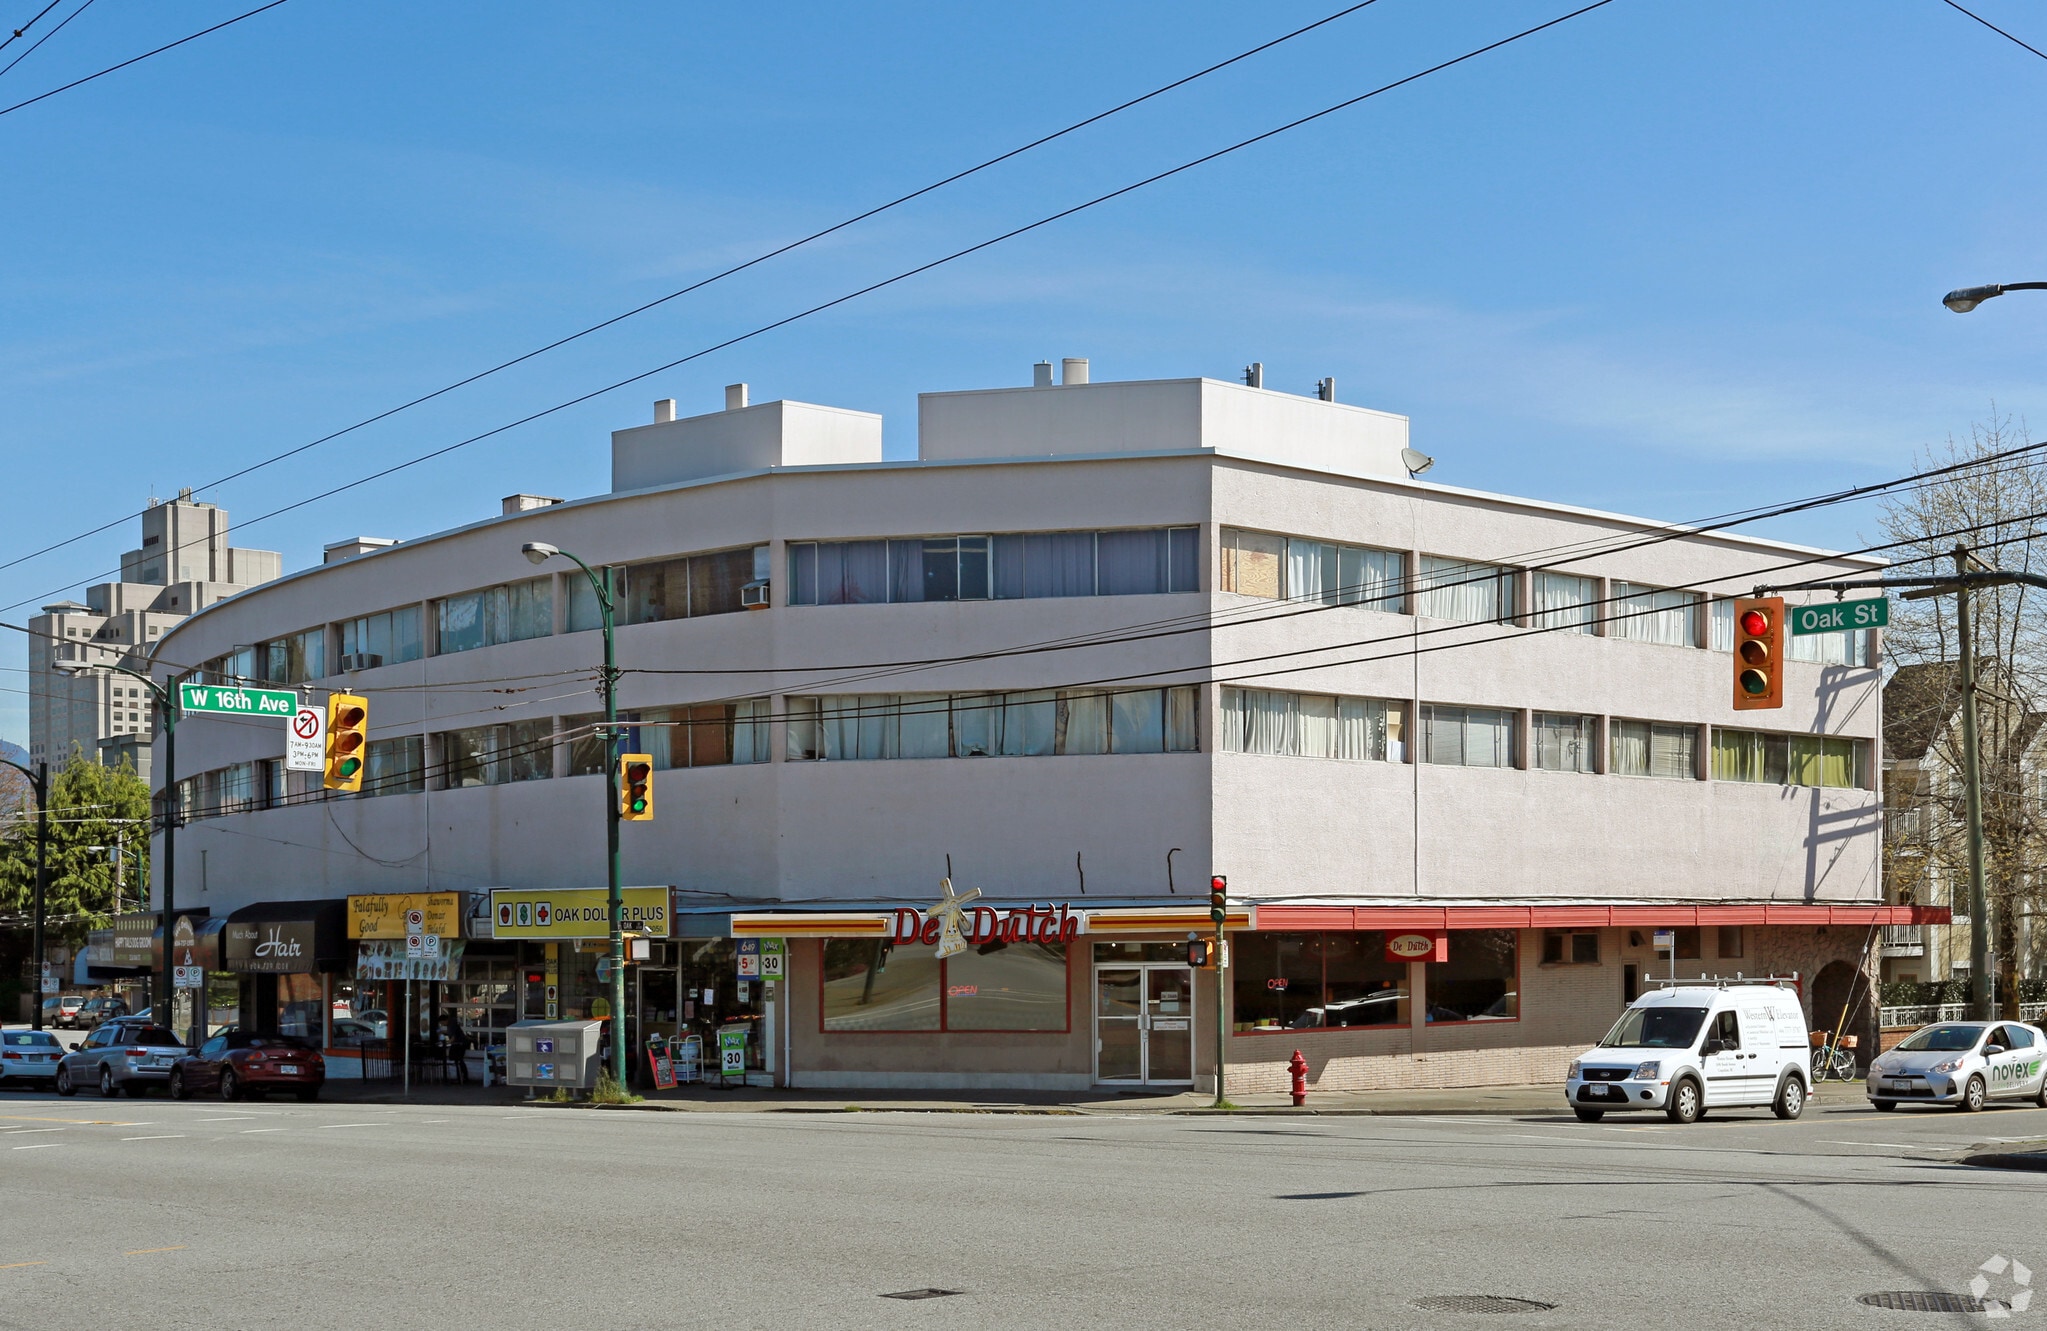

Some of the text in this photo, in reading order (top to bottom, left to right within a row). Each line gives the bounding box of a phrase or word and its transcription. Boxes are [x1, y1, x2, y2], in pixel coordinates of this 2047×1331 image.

[1802, 604, 1878, 629] Oak St
[190, 689, 289, 712] W 16th Ave
[293, 751, 319, 759] 3PM-6PM
[353, 897, 389, 917] Falafully
[555, 906, 664, 921] OAK DOLR PLUS
[359, 917, 380, 937] Good
[892, 903, 1080, 945] De Dutch
[245, 930, 258, 939] About
[255, 925, 302, 957] Hair
[1393, 940, 1429, 951] De Dutch
[948, 985, 978, 996] OPEN
[1267, 977, 1289, 990] OPEN
[1742, 1008, 1767, 1020] Western
[1775, 1008, 1799, 1020] Elevator
[1992, 1062, 2029, 1081] novex
[2006, 1080, 2030, 1088] DELIVERY
